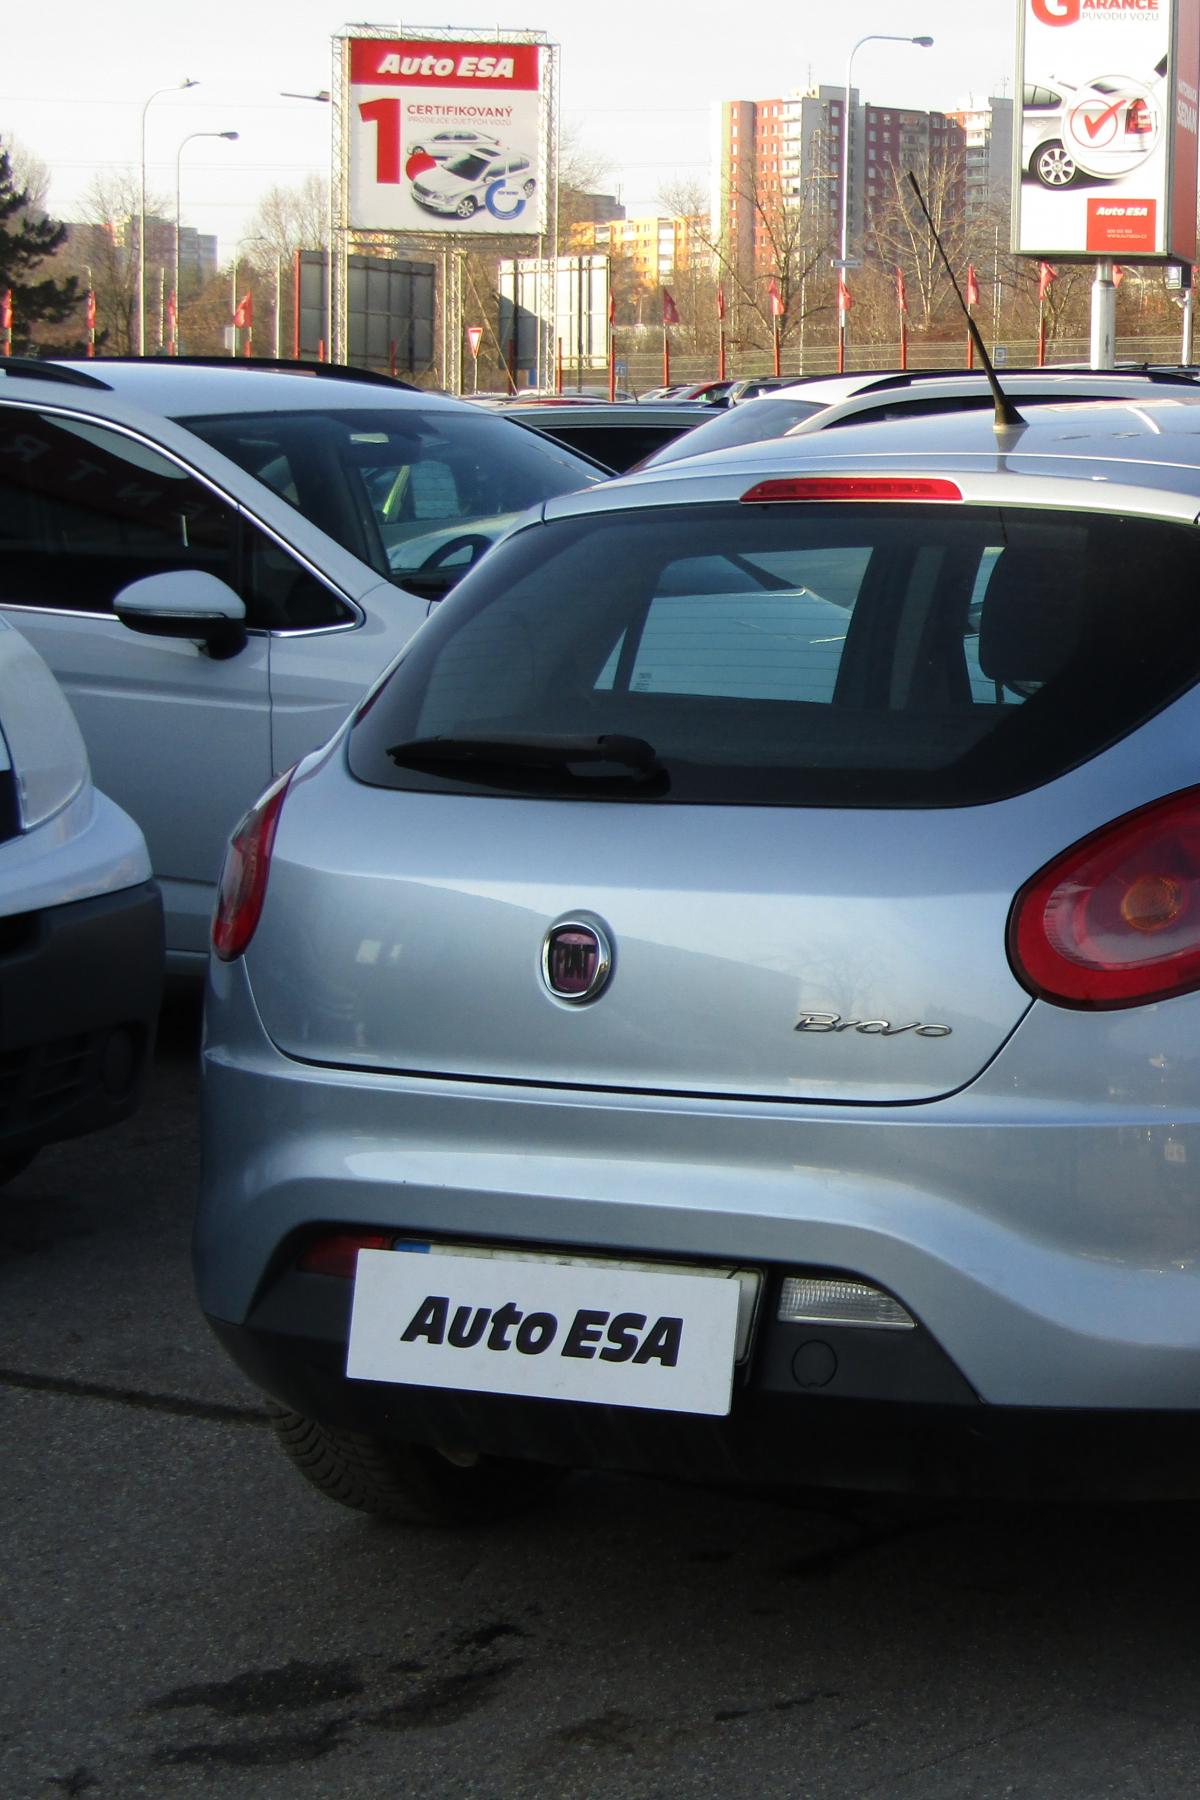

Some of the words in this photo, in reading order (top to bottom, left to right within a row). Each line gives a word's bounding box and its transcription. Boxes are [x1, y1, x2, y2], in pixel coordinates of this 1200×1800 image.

[377, 54, 455, 76] Auto
[457, 57, 514, 78] ESA
[407, 104, 512, 117] CERTIFIKOVANÝ
[1096, 206, 1125, 216] Auto
[1126, 207, 1148, 217] ESA
[793, 1011, 952, 1037] Bravo
[400, 1296, 558, 1355] Auto
[560, 1309, 683, 1367] ESA
